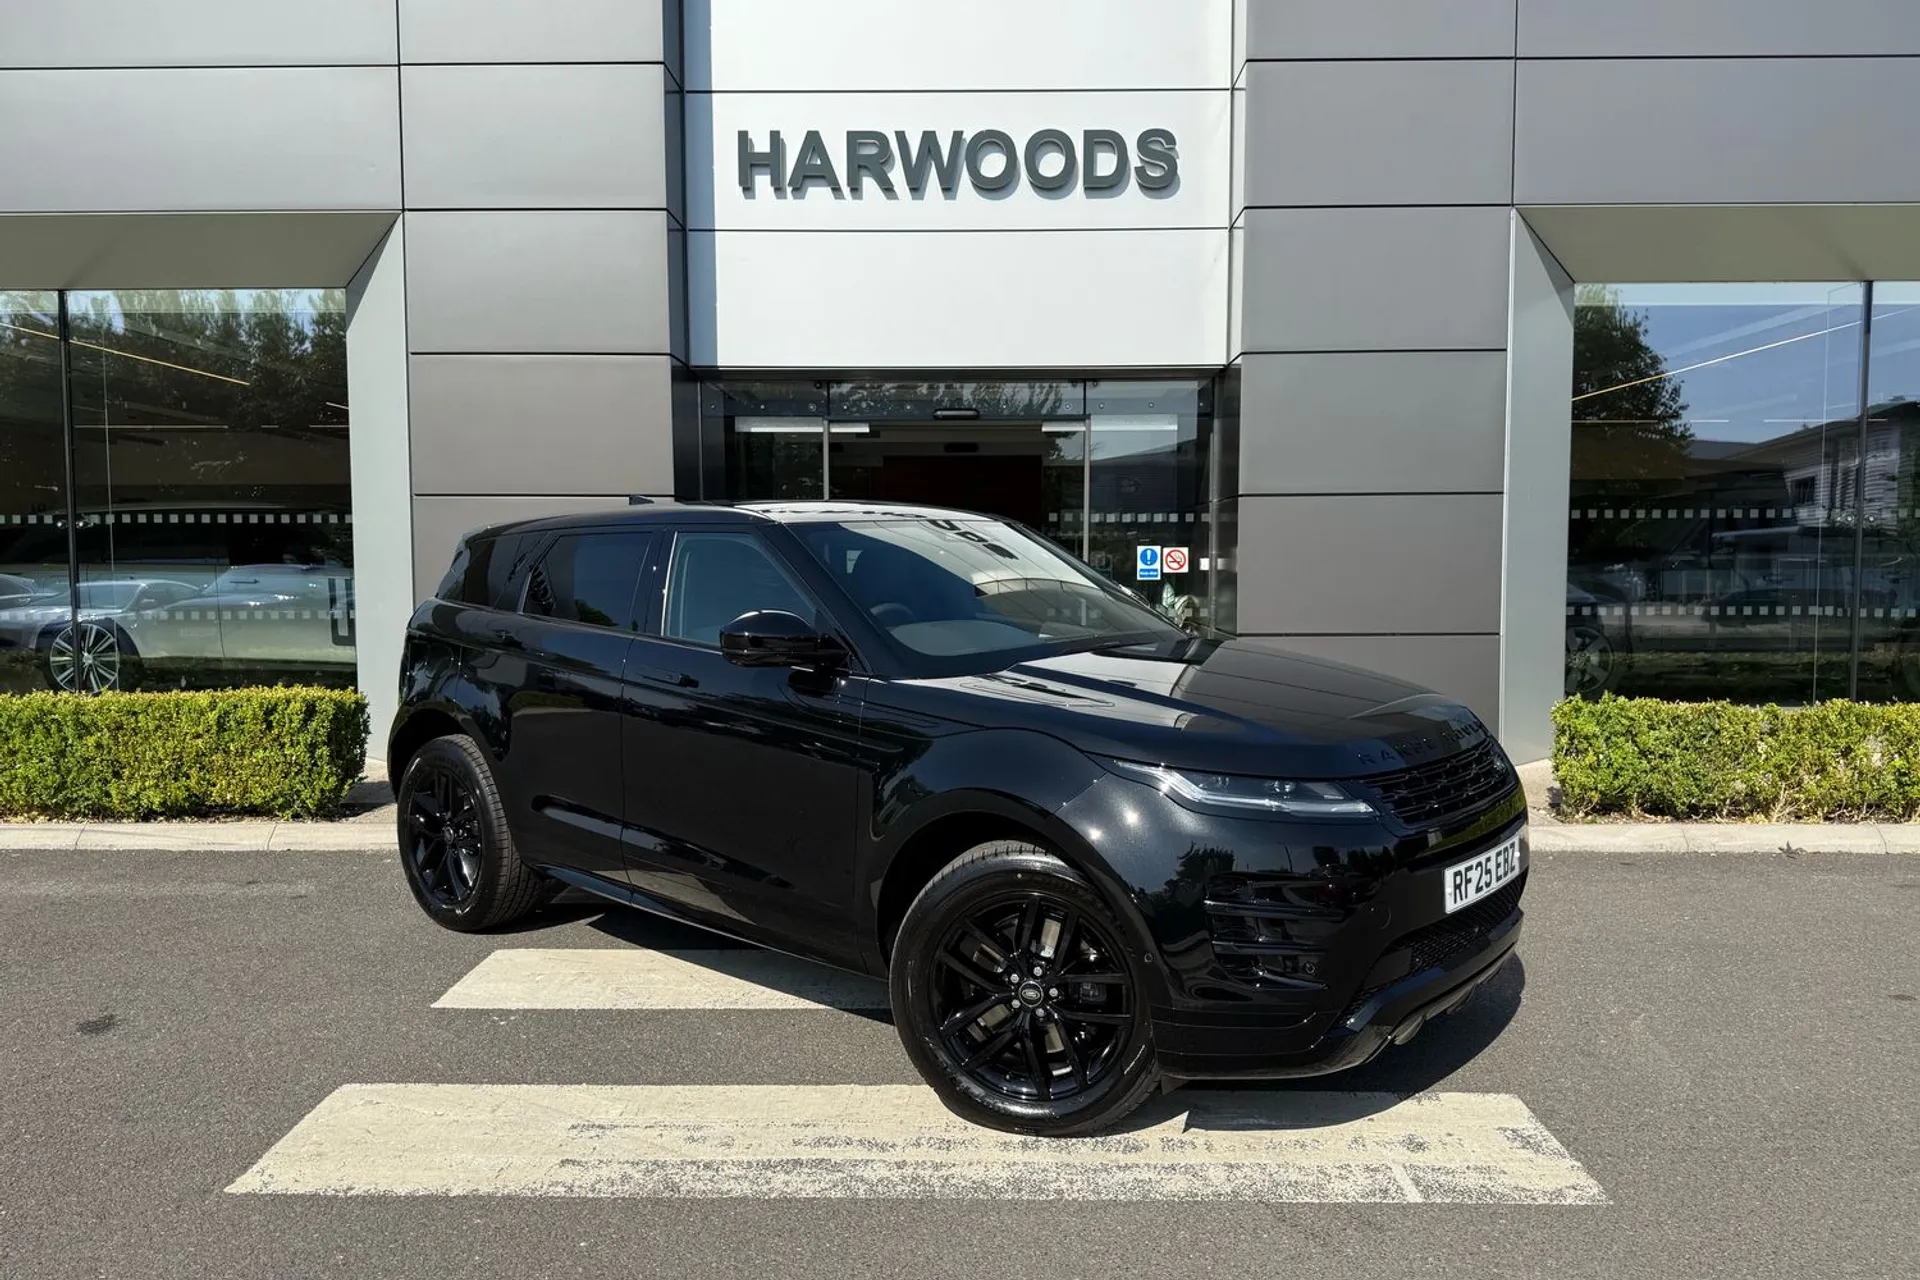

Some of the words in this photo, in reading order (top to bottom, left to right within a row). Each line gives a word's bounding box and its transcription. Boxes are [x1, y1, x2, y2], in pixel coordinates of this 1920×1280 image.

[738, 128, 1178, 192] HARWOODS
[1453, 856, 1492, 904] RF25
[1495, 841, 1515, 882] EBZ
